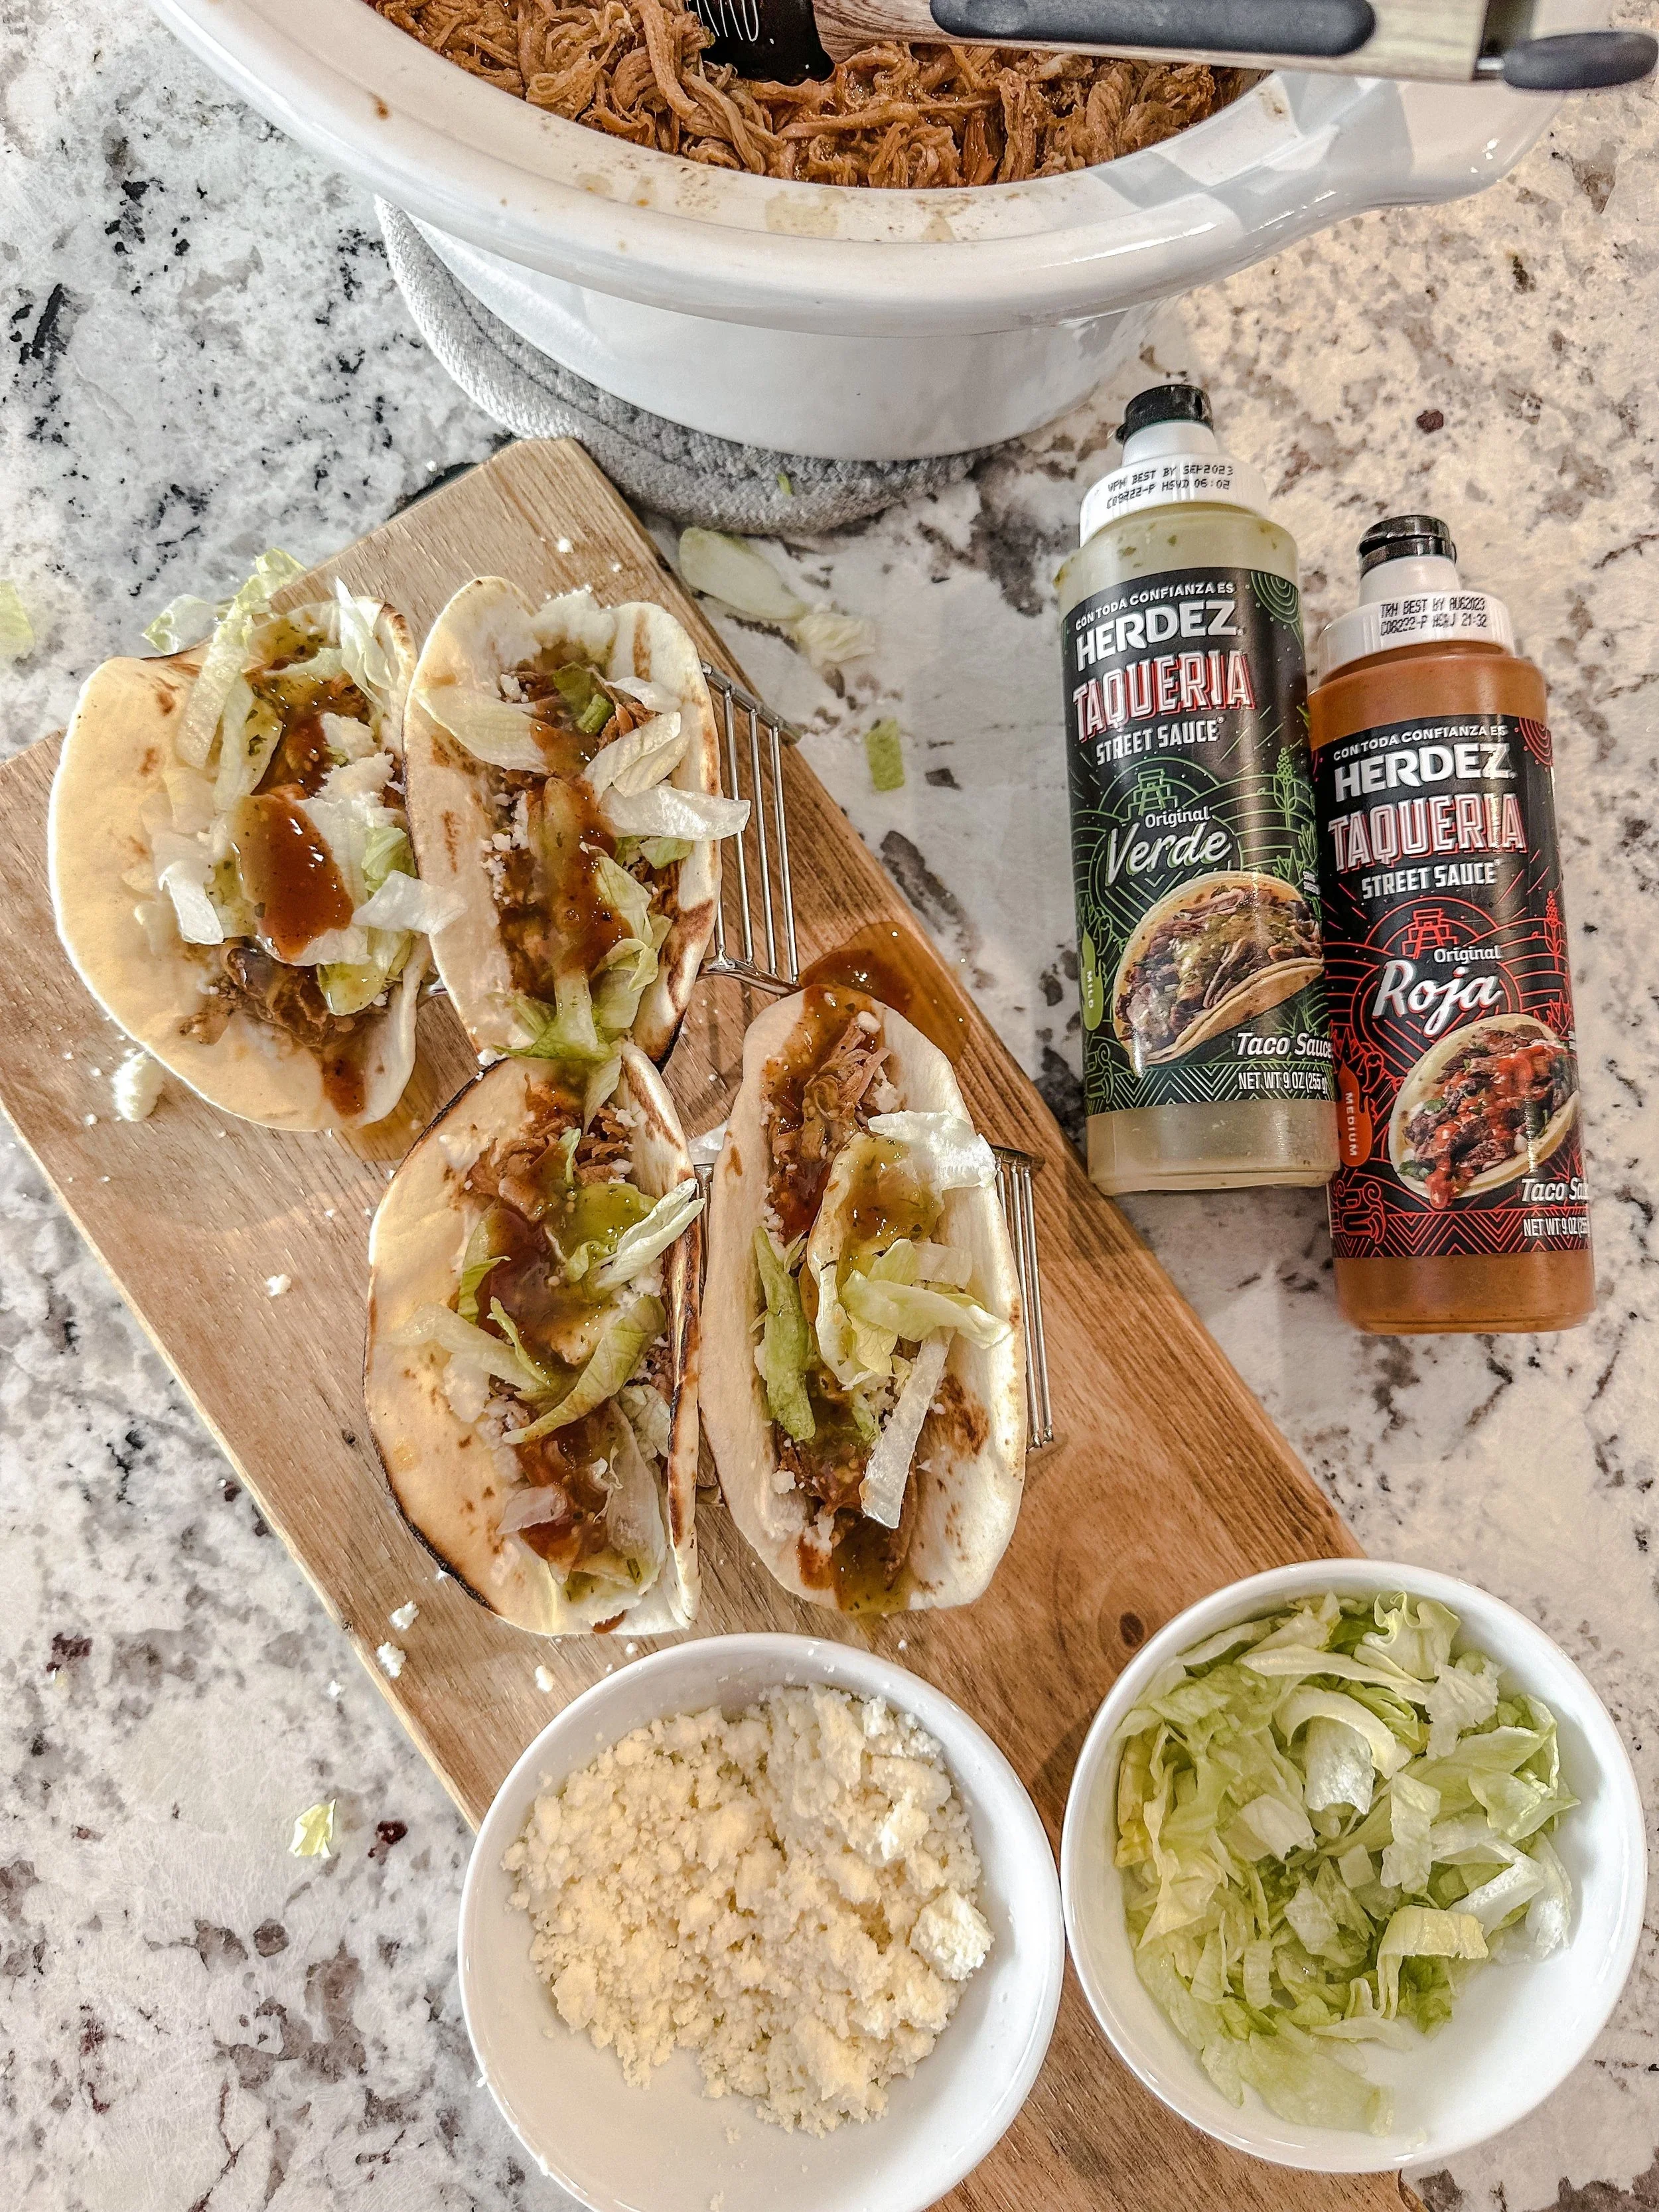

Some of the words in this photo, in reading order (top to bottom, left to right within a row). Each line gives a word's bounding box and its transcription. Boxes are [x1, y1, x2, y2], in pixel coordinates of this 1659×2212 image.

[1132, 471, 1157, 484] BEST
[1163, 467, 1177, 477] BY
[1075, 611, 1095, 631] CON
[1095, 599, 1128, 619] TODA
[1129, 583, 1213, 606] CONFIANZA
[1216, 581, 1235, 594] ES
[1402, 599, 1428, 615] BEST
[1432, 597, 1445, 611] BY
[1076, 599, 1238, 672] HERDEZ
[1072, 648, 1256, 745] TAQUERIA
[1096, 729, 1153, 766] STREET
[1333, 744, 1360, 761] CON
[1360, 735, 1400, 753] TODA
[1401, 725, 1488, 744] CONFIANZA
[1490, 725, 1508, 737] ES
[1334, 742, 1511, 802] HERDEZ
[1145, 806, 1211, 828] Original
[1328, 792, 1528, 875] TAQUERIA
[1105, 822, 1233, 887] Verde
[1361, 867, 1431, 899] STREET
[1433, 945, 1502, 964] Original
[1372, 960, 1504, 1039] Roja
[1236, 1032, 1291, 1056] Taco
[1238, 1072, 1260, 1090] NET
[1263, 1072, 1281, 1089] WT
[1283, 1072, 1289, 1089] 9
[1291, 1072, 1305, 1089] OZ
[1345, 1092, 1358, 1156] MEDIUM
[1521, 1178, 1567, 1202] Taco
[1523, 1218, 1545, 1236] NET
[1546, 1218, 1561, 1235] WT
[1561, 1217, 1567, 1234] 9
[1567, 1217, 1577, 1234] OZ
